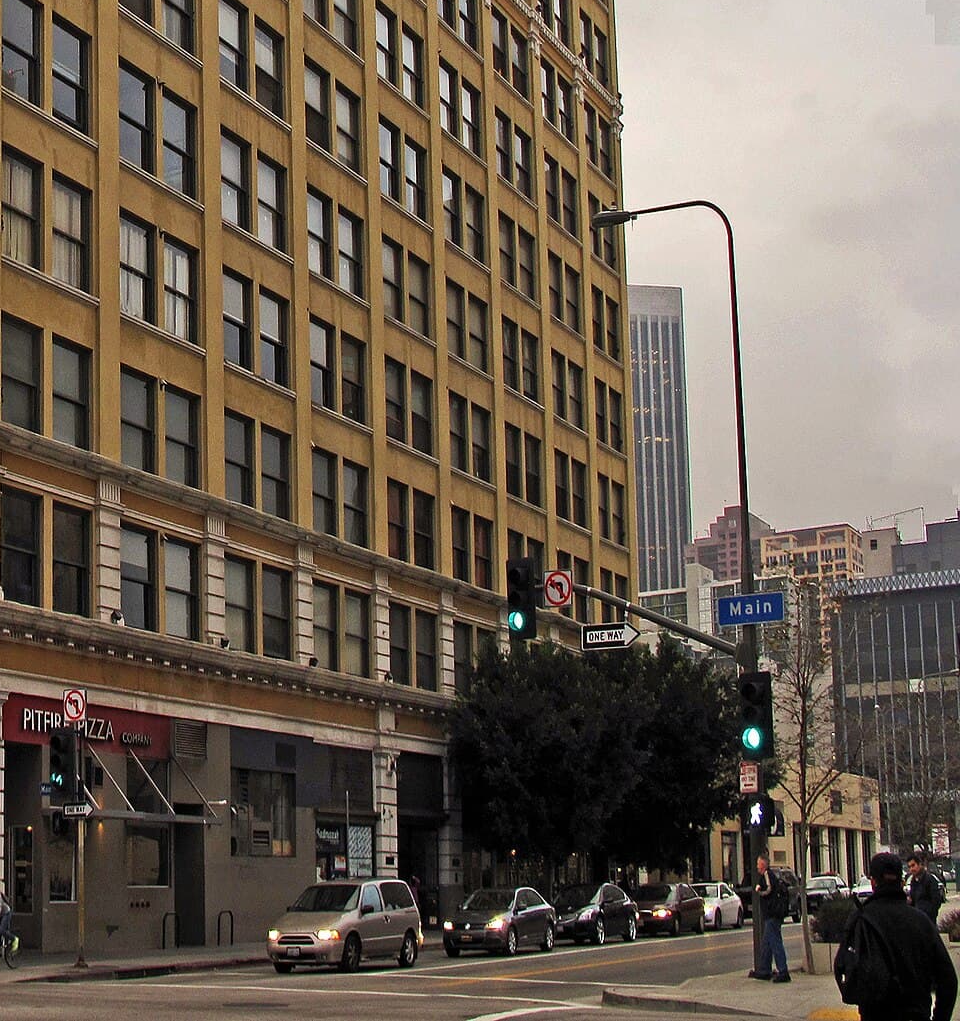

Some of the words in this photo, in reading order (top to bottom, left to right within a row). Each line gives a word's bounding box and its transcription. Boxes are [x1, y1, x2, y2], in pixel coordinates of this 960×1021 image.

[729, 599, 772, 617] Main
[588, 631, 605, 642] ONE
[606, 630, 624, 641] WAY
